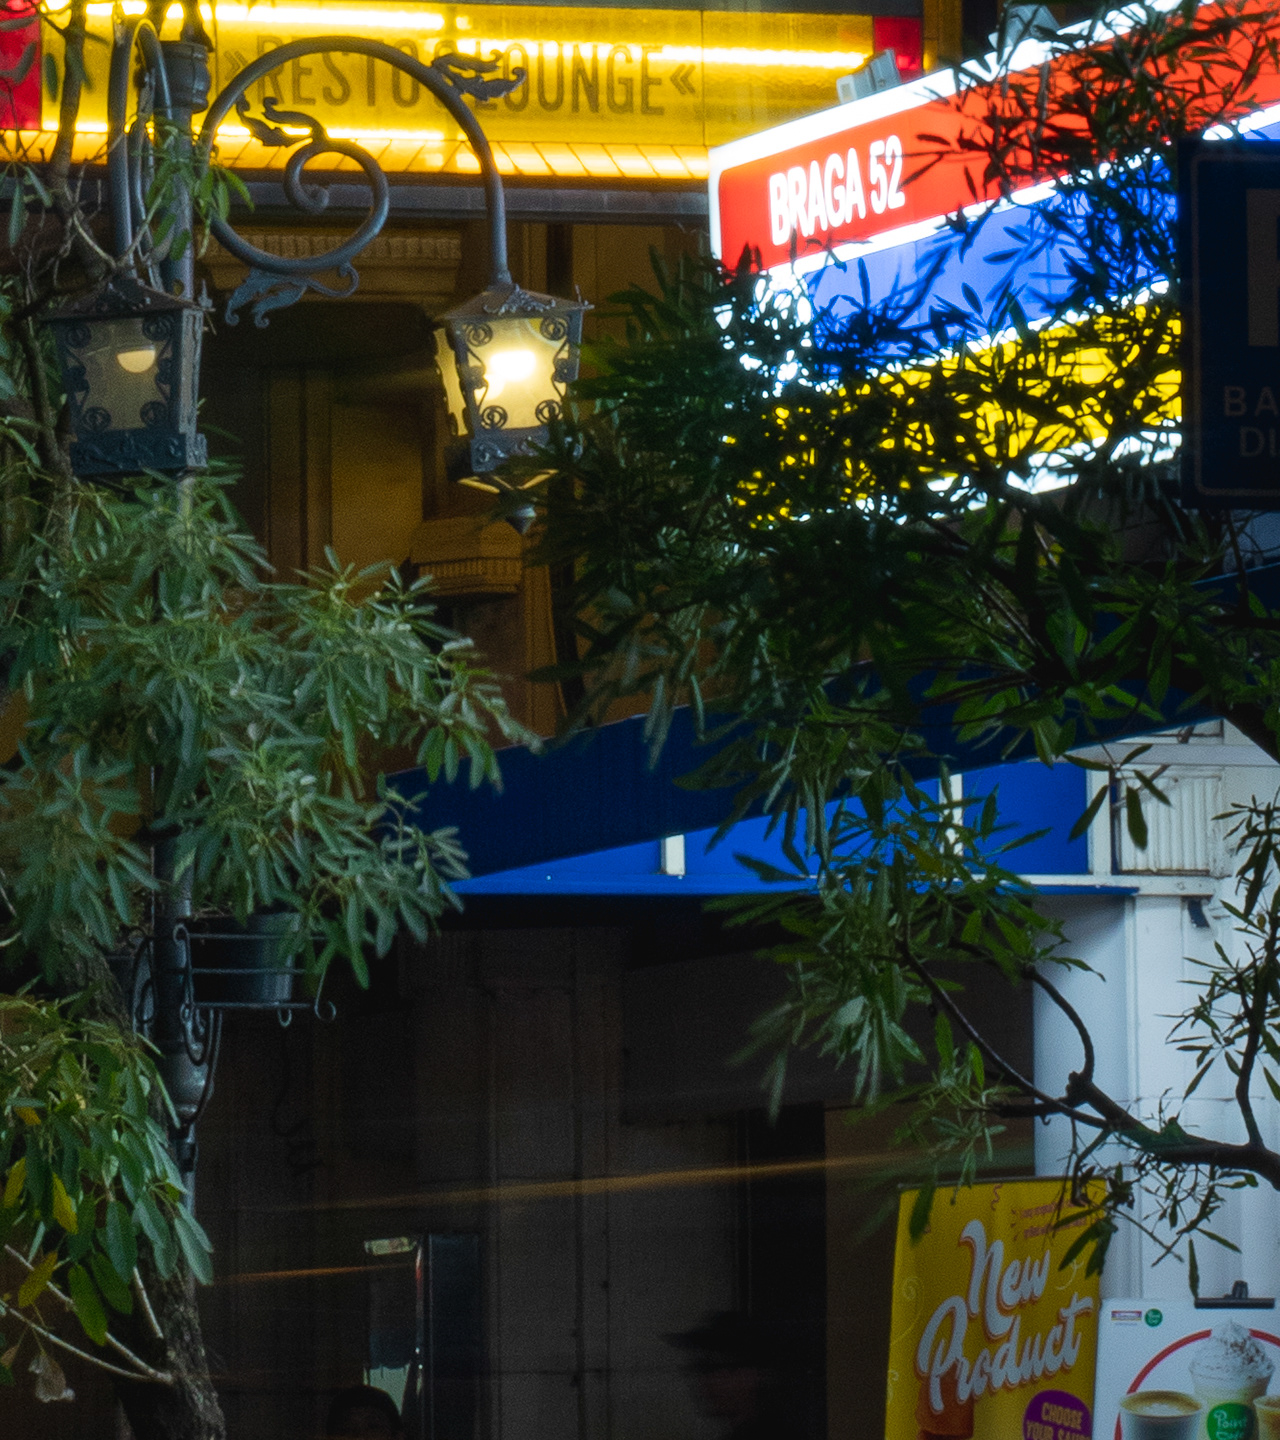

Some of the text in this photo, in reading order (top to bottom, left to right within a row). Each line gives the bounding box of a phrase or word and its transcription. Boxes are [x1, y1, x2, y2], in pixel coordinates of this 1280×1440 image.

[769, 134, 906, 246] BRAGA 52
[961, 1219, 1051, 1340] New
[917, 1292, 1094, 1413] Product
[1041, 1401, 1084, 1429] CHOOSE
